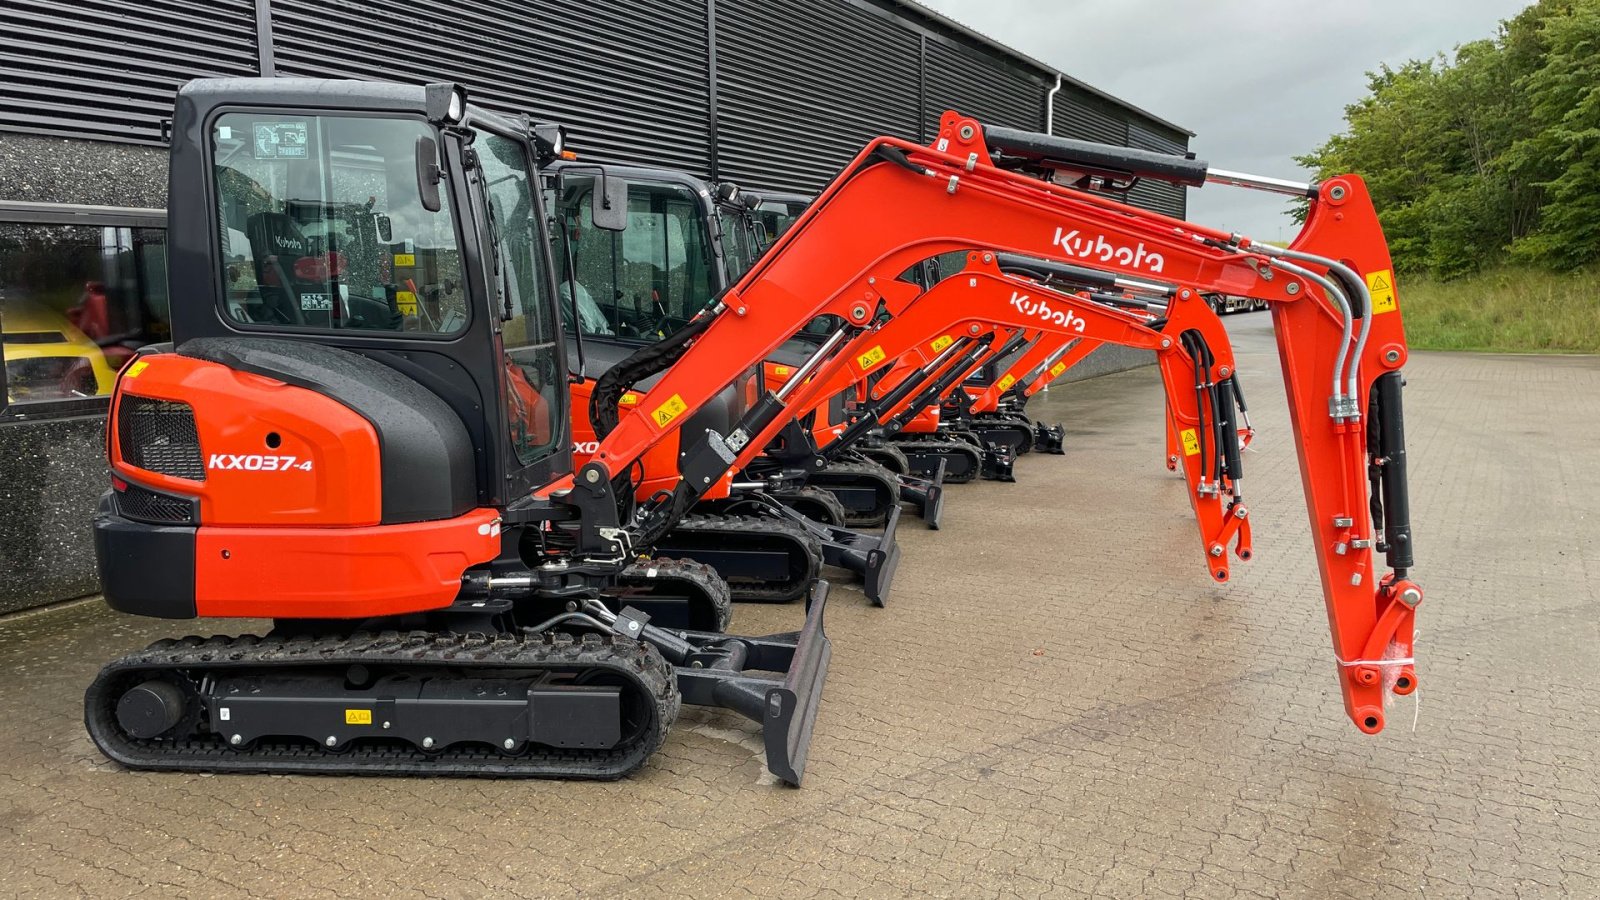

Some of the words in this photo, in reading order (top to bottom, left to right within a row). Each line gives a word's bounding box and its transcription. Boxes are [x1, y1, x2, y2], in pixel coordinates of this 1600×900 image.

[274, 235, 303, 250] Kubota
[1053, 227, 1164, 272] Kubota
[1010, 291, 1086, 332] Kubota
[208, 454, 313, 472] KX037-4
